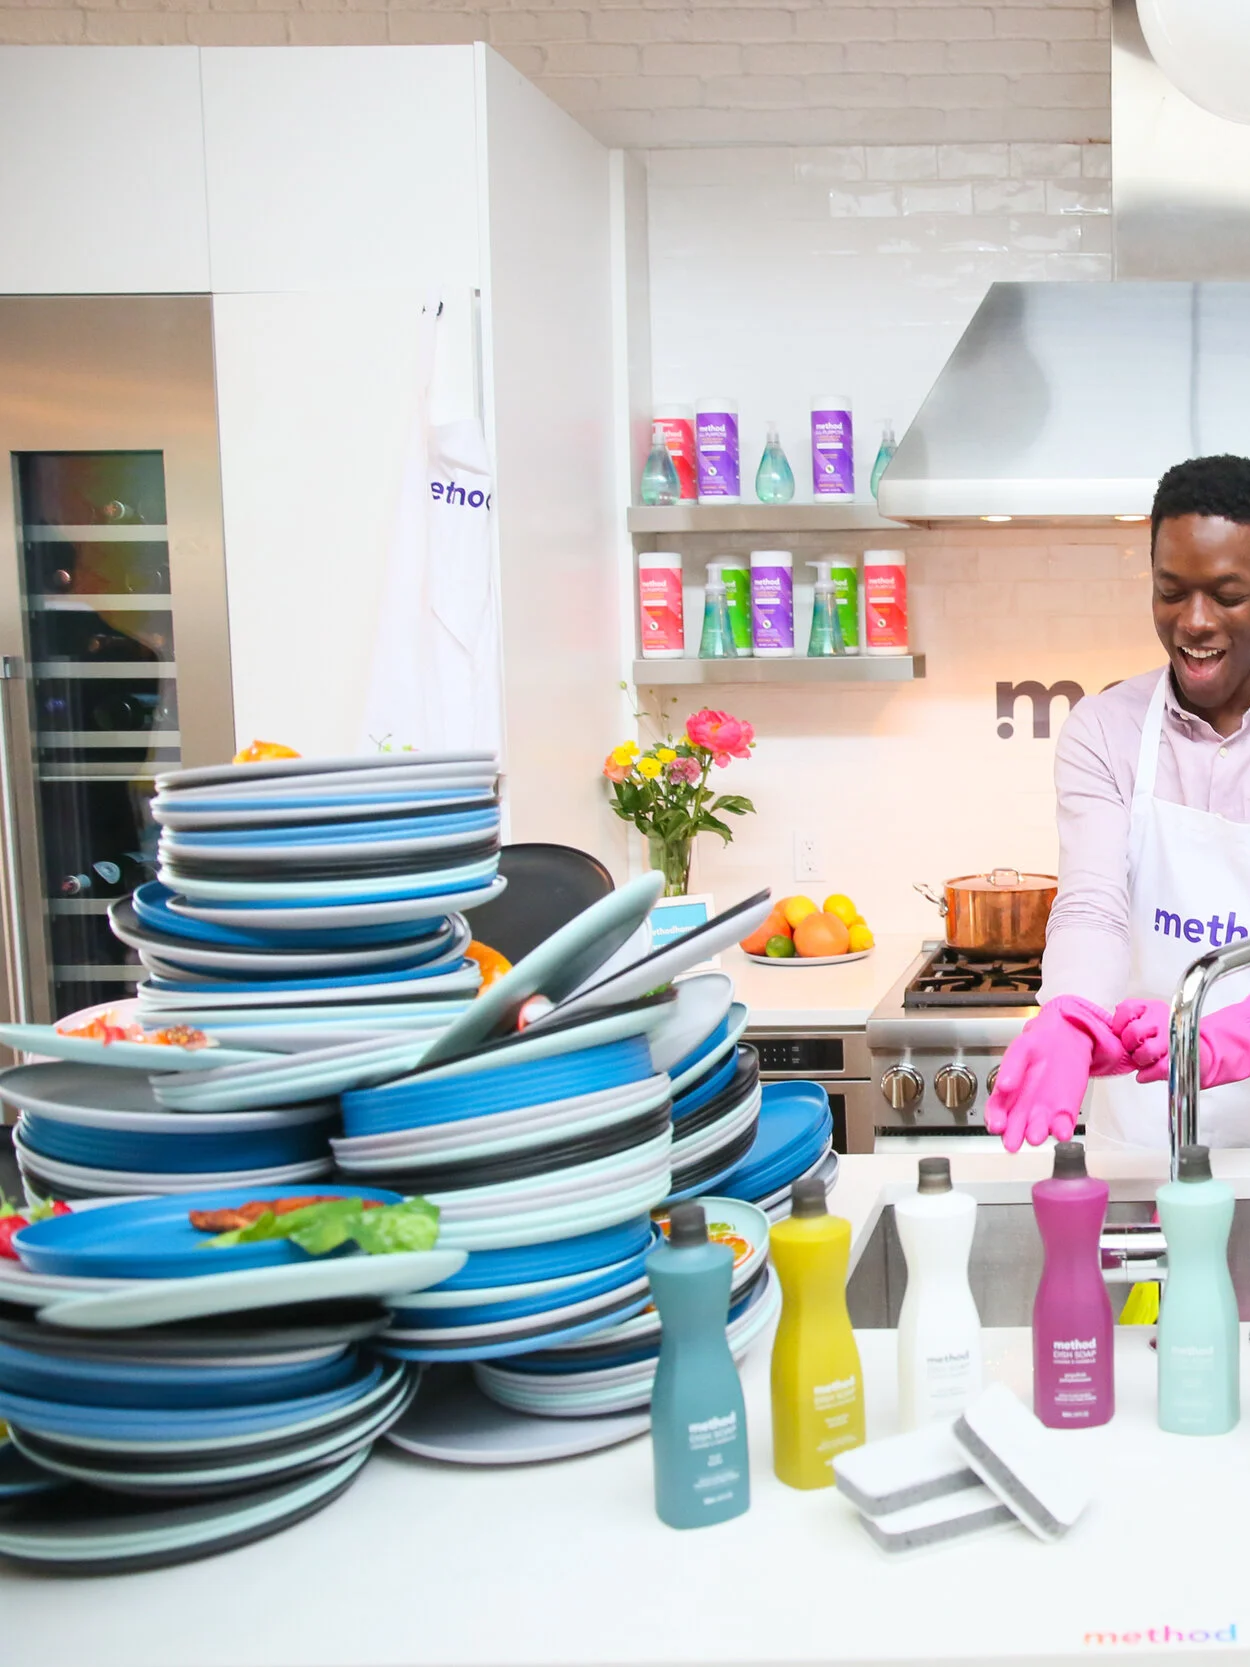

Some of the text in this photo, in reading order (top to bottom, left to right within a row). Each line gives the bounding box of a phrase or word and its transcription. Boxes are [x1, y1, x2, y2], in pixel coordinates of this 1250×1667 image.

[815, 422, 843, 430] method
[431, 481, 491, 511] etho
[754, 578, 780, 586] method
[1053, 1337, 1096, 1350] method
[1171, 1345, 1214, 1355] method
[927, 1350, 970, 1363] method
[1053, 1349, 1097, 1359] DISH SOAP
[814, 1374, 855, 1394] method
[688, 1410, 737, 1432] method
[1084, 1624, 1237, 1644] method
